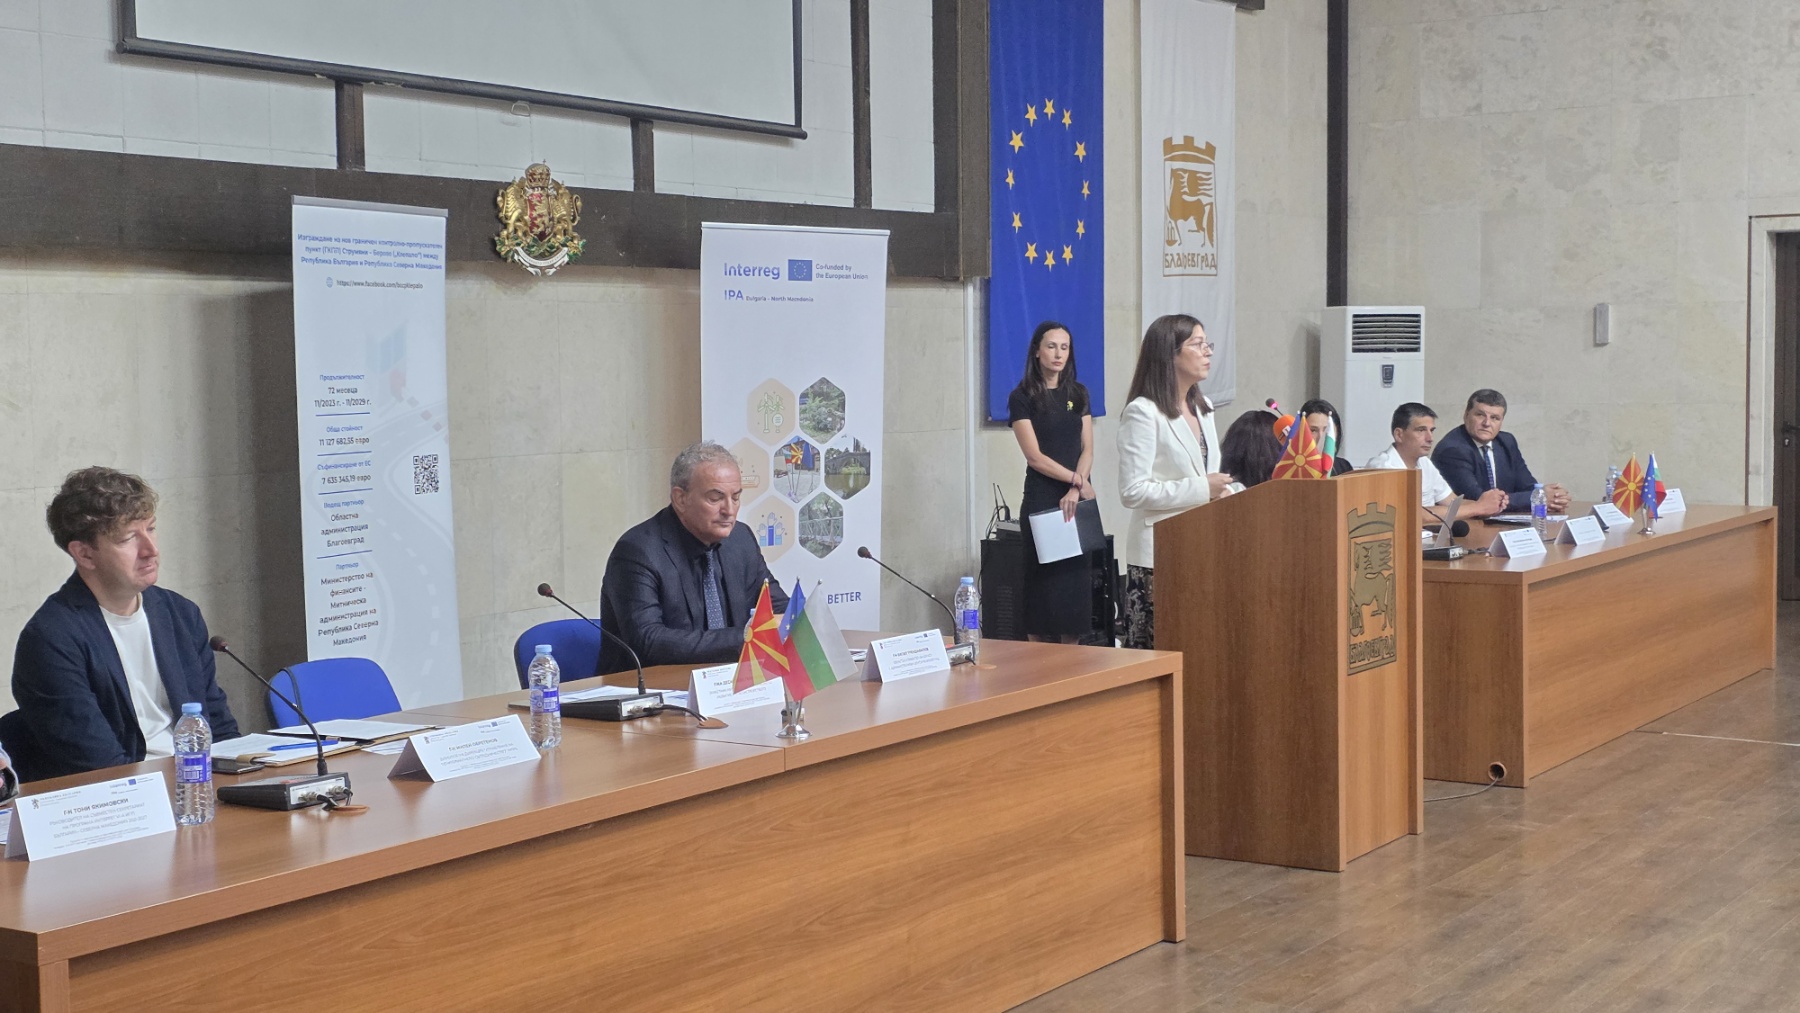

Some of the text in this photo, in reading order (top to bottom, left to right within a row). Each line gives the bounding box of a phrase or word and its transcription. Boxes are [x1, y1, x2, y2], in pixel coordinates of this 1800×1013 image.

[298, 233, 333, 243] Изграждане
[352, 238, 377, 246] граничен
[305, 246, 321, 254] пункт
[301, 256, 331, 266] Република
[333, 258, 358, 267] България
[364, 260, 392, 268] Република
[393, 261, 414, 269] Северна
[815, 263, 852, 273] Co-funded by
[724, 262, 780, 280] Interreg
[724, 289, 744, 301] IPA
[328, 386, 358, 395] 72 месеца
[314, 399, 336, 408] 11/2023
[345, 397, 366, 407] 11/2029
[326, 425, 340, 433] Обща
[355, 437, 370, 446] евро
[317, 462, 357, 471] Съфинансиране
[321, 477, 326, 485] 7
[342, 499, 364, 507] партньор
[330, 513, 359, 522] Областна
[321, 524, 369, 536] администрация
[327, 536, 365, 548] Благоевград
[321, 573, 365, 585] Министерство
[330, 586, 362, 598] финансите
[827, 591, 862, 605] BETTER
[330, 598, 367, 609] Митническа
[319, 609, 368, 624] администрация
[318, 620, 379, 636] Република Северна
[333, 634, 367, 646] Македония
[74, 805, 91, 813] ТОНИ
[92, 798, 129, 810] ЯКИМОВСКИ
